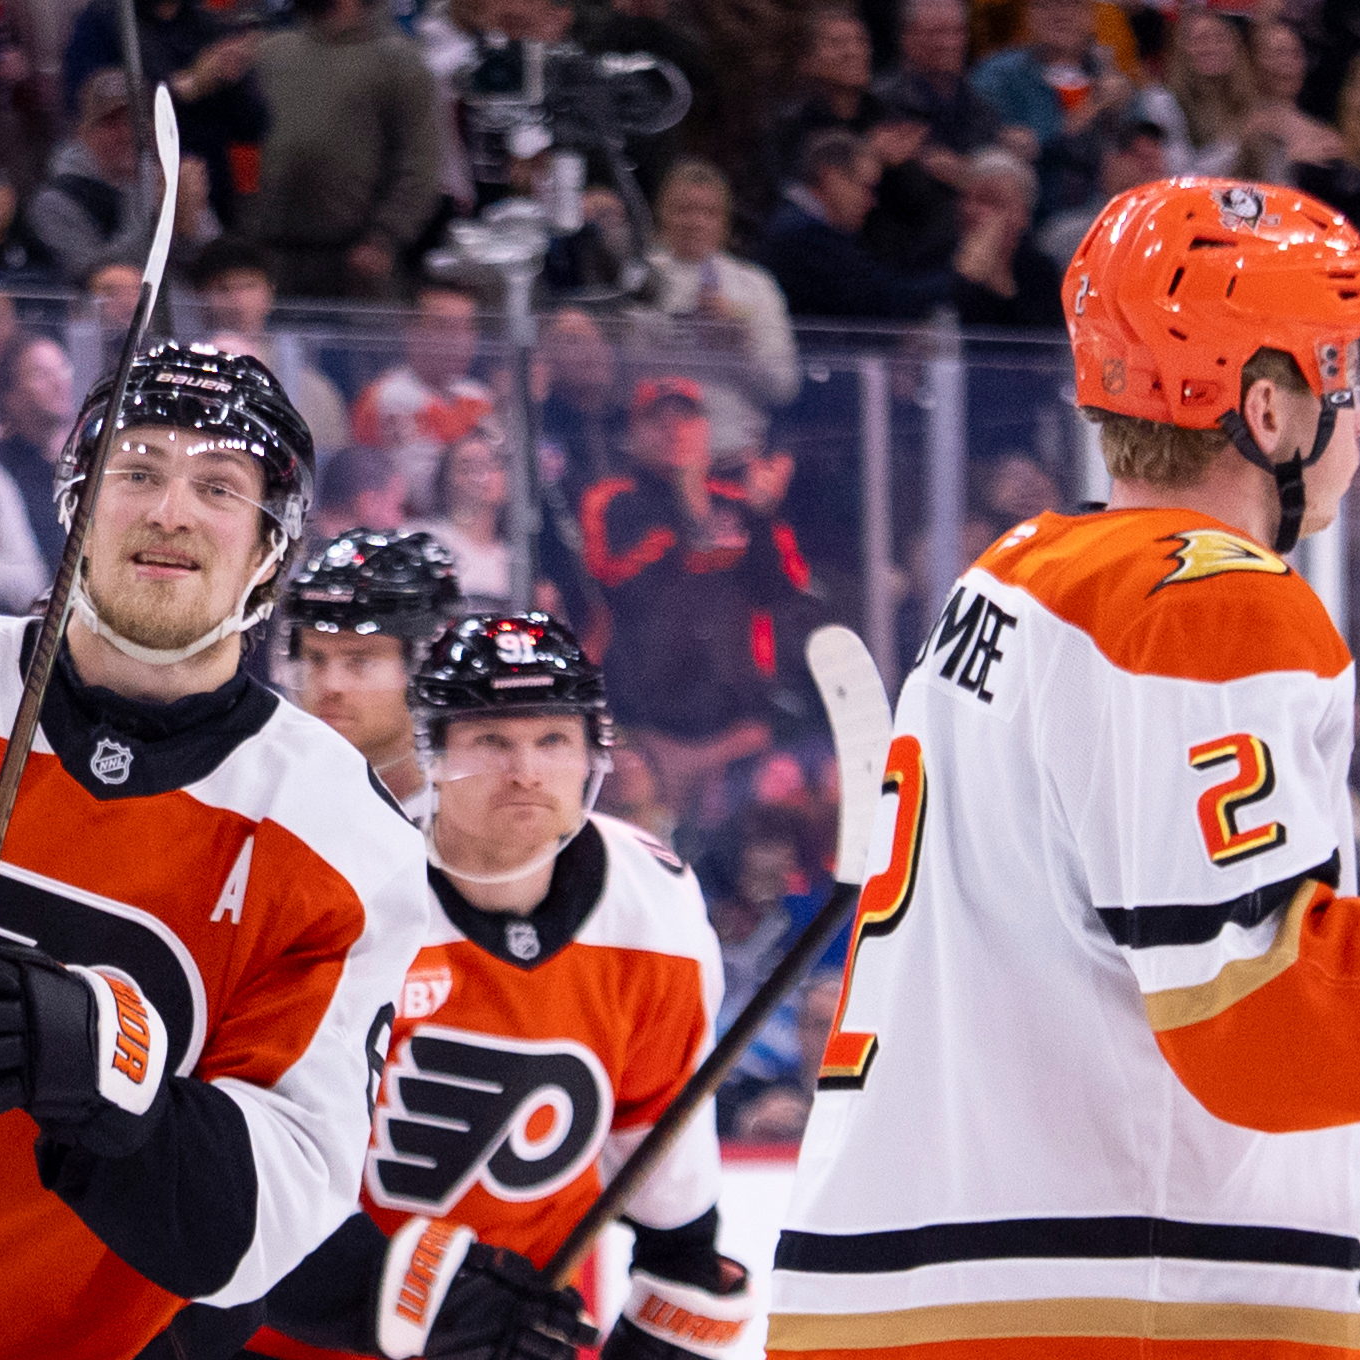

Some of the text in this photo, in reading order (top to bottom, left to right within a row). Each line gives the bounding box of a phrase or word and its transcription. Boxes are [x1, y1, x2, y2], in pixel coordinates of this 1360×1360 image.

[156, 371, 233, 394] BAUER
[913, 586, 1019, 705] MBE
[1187, 732, 1288, 868] 2
[208, 833, 255, 926] A
